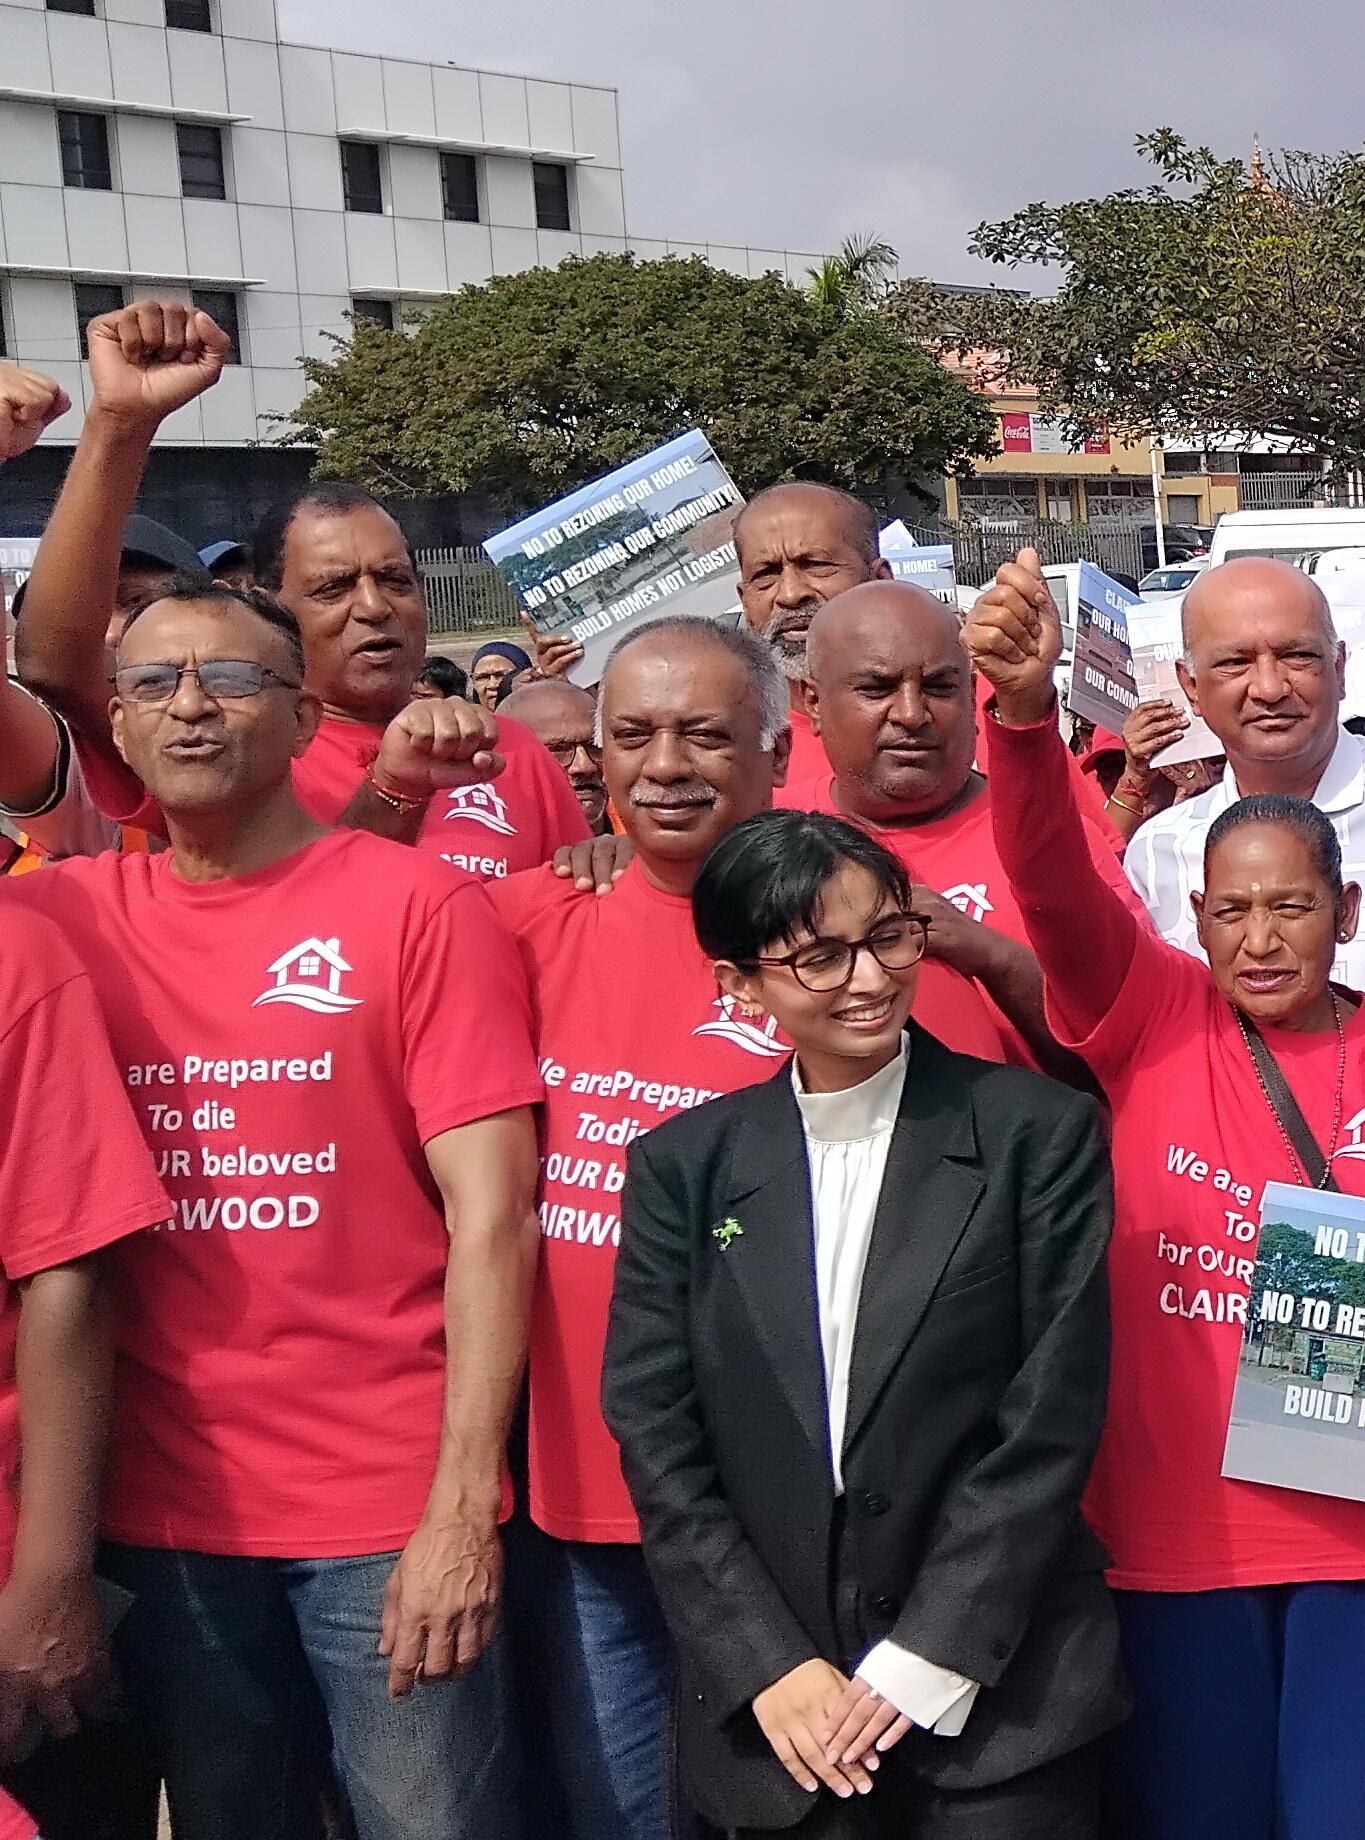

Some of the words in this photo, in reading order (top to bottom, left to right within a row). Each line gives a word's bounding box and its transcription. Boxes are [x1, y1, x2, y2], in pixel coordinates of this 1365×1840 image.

[521, 538, 542, 560] NO
[542, 528, 563, 548] TO
[560, 491, 624, 540] REZONING
[623, 478, 652, 505] OUR
[650, 455, 696, 490] HOME!
[523, 585, 547, 609] NO
[543, 576, 566, 598] TO
[562, 543, 631, 587] REZONING
[625, 527, 655, 555] OUR
[653, 482, 739, 540] COMMUNITY!
[571, 611, 612, 642] BUILD
[609, 586, 660, 622] HOMES
[657, 570, 685, 597] NOT
[683, 540, 738, 582] LOGISTIC
[1092, 608, 1111, 634] OUR
[1085, 666, 1105, 692] OUR
[128, 1062, 175, 1086] are
[184, 1051, 332, 1089] Prepared
[148, 1104, 183, 1132] To
[192, 1100, 235, 1130] die
[201, 1142, 336, 1177] beloved
[546, 1153, 602, 1190] OUR
[1167, 1144, 1209, 1182] We
[1213, 1168, 1253, 1207] are
[1224, 1210, 1255, 1242] To
[1314, 1225, 1348, 1259] NO
[1157, 1232, 1193, 1267] For
[1197, 1245, 1255, 1287] OUR
[1260, 1290, 1295, 1325] NO
[1299, 1297, 1330, 1330] TO
[1283, 1384, 1352, 1425] BUILD
